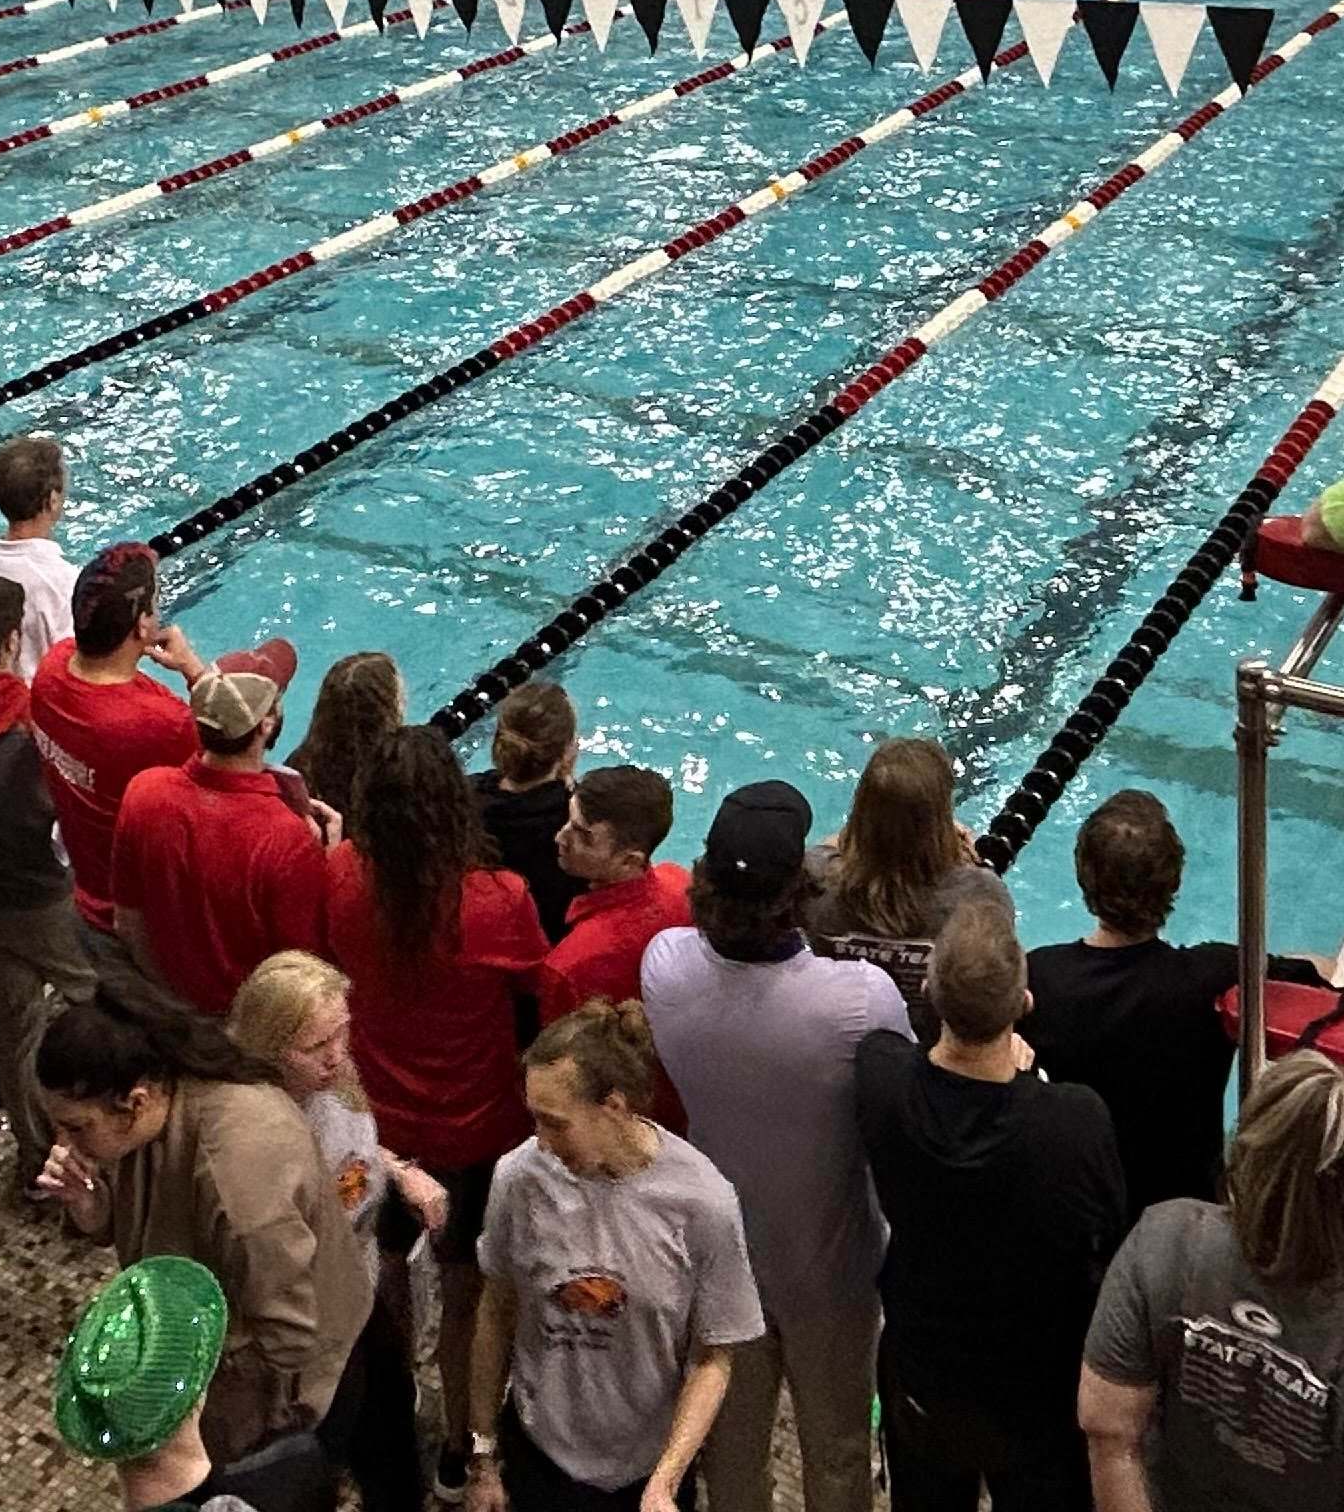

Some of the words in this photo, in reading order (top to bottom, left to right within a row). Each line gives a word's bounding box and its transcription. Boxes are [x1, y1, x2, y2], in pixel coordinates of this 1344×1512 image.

[834, 941, 893, 963] STATE
[1184, 1328, 1257, 1369] STATE
[1261, 1357, 1329, 1408] TEAM
